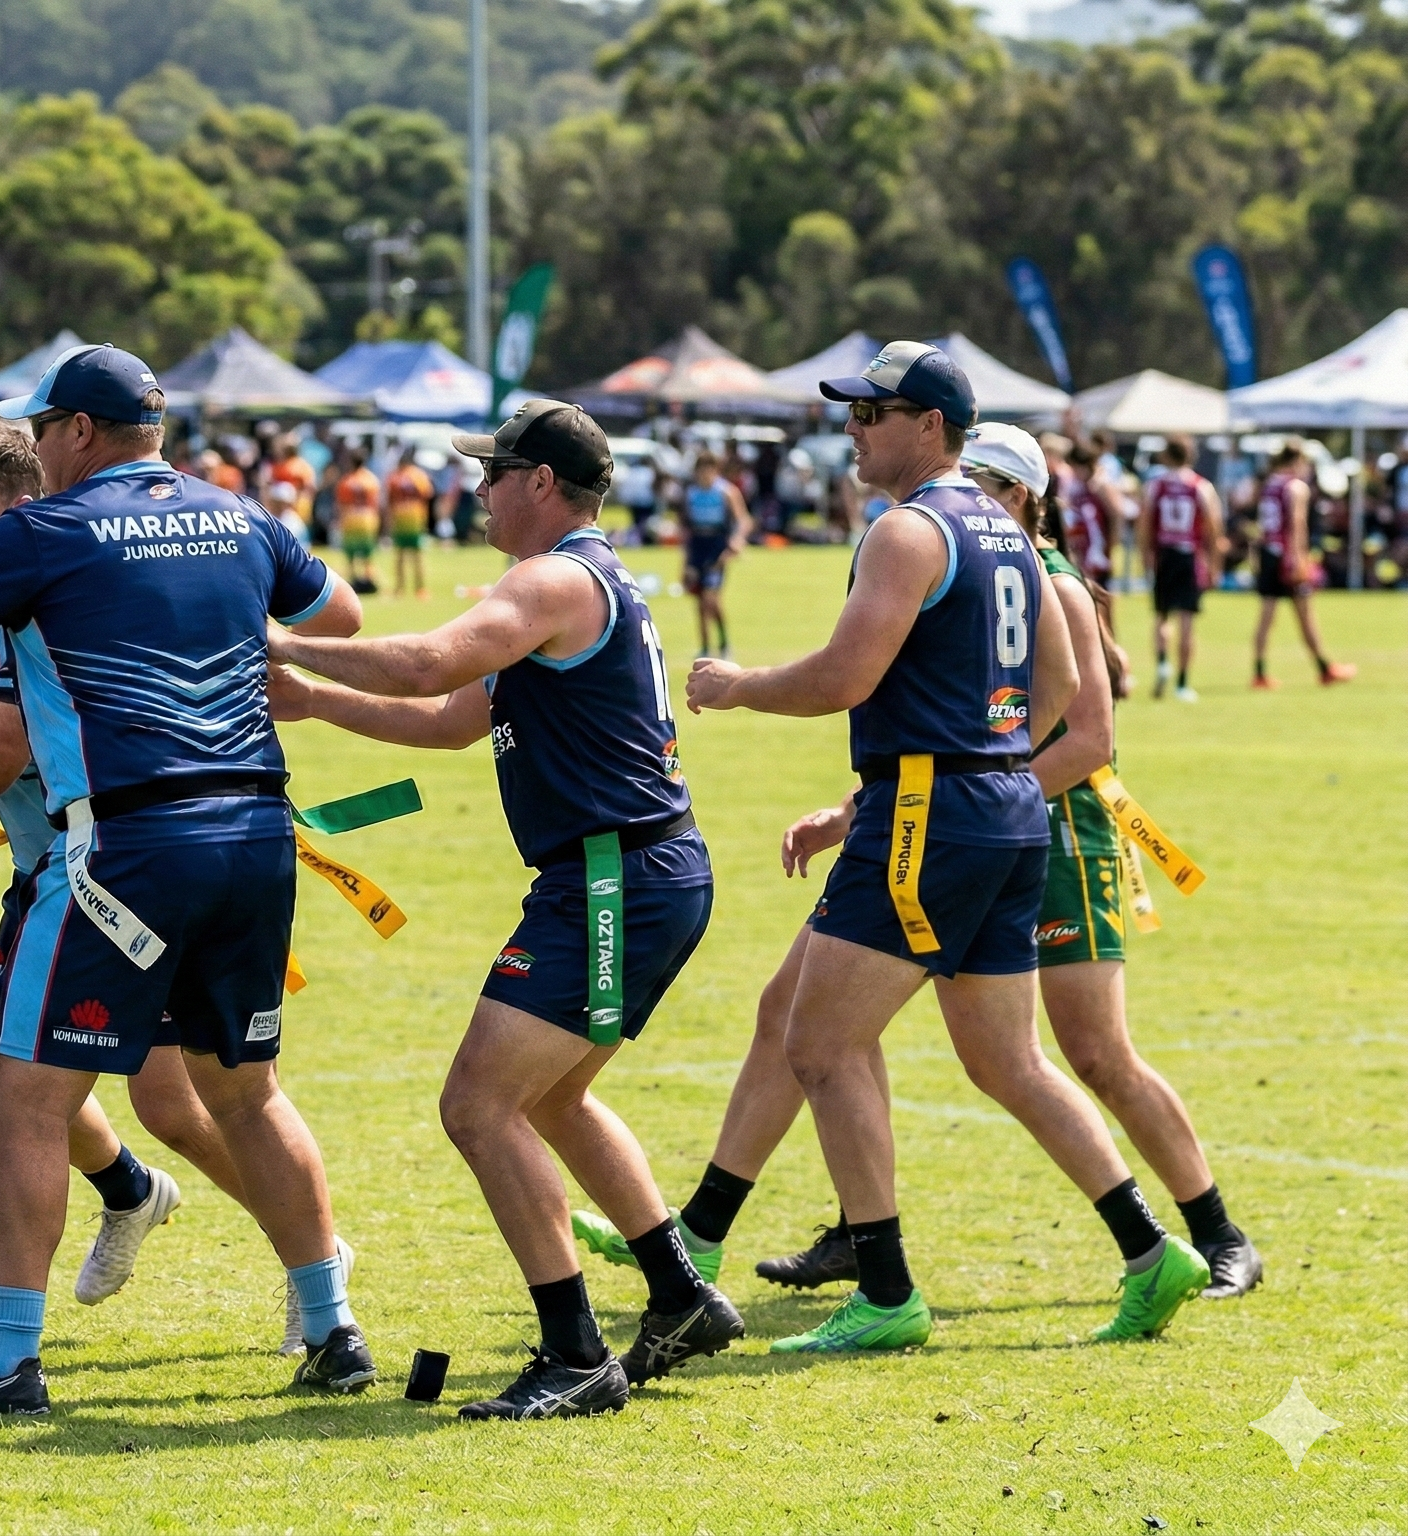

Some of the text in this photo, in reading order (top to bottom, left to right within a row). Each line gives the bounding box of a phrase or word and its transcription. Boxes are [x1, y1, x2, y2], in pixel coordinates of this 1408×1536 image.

[88, 511, 250, 543] WARATANS
[122, 539, 238, 561] JUNIOR OZTAG
[994, 566, 1027, 668] 8
